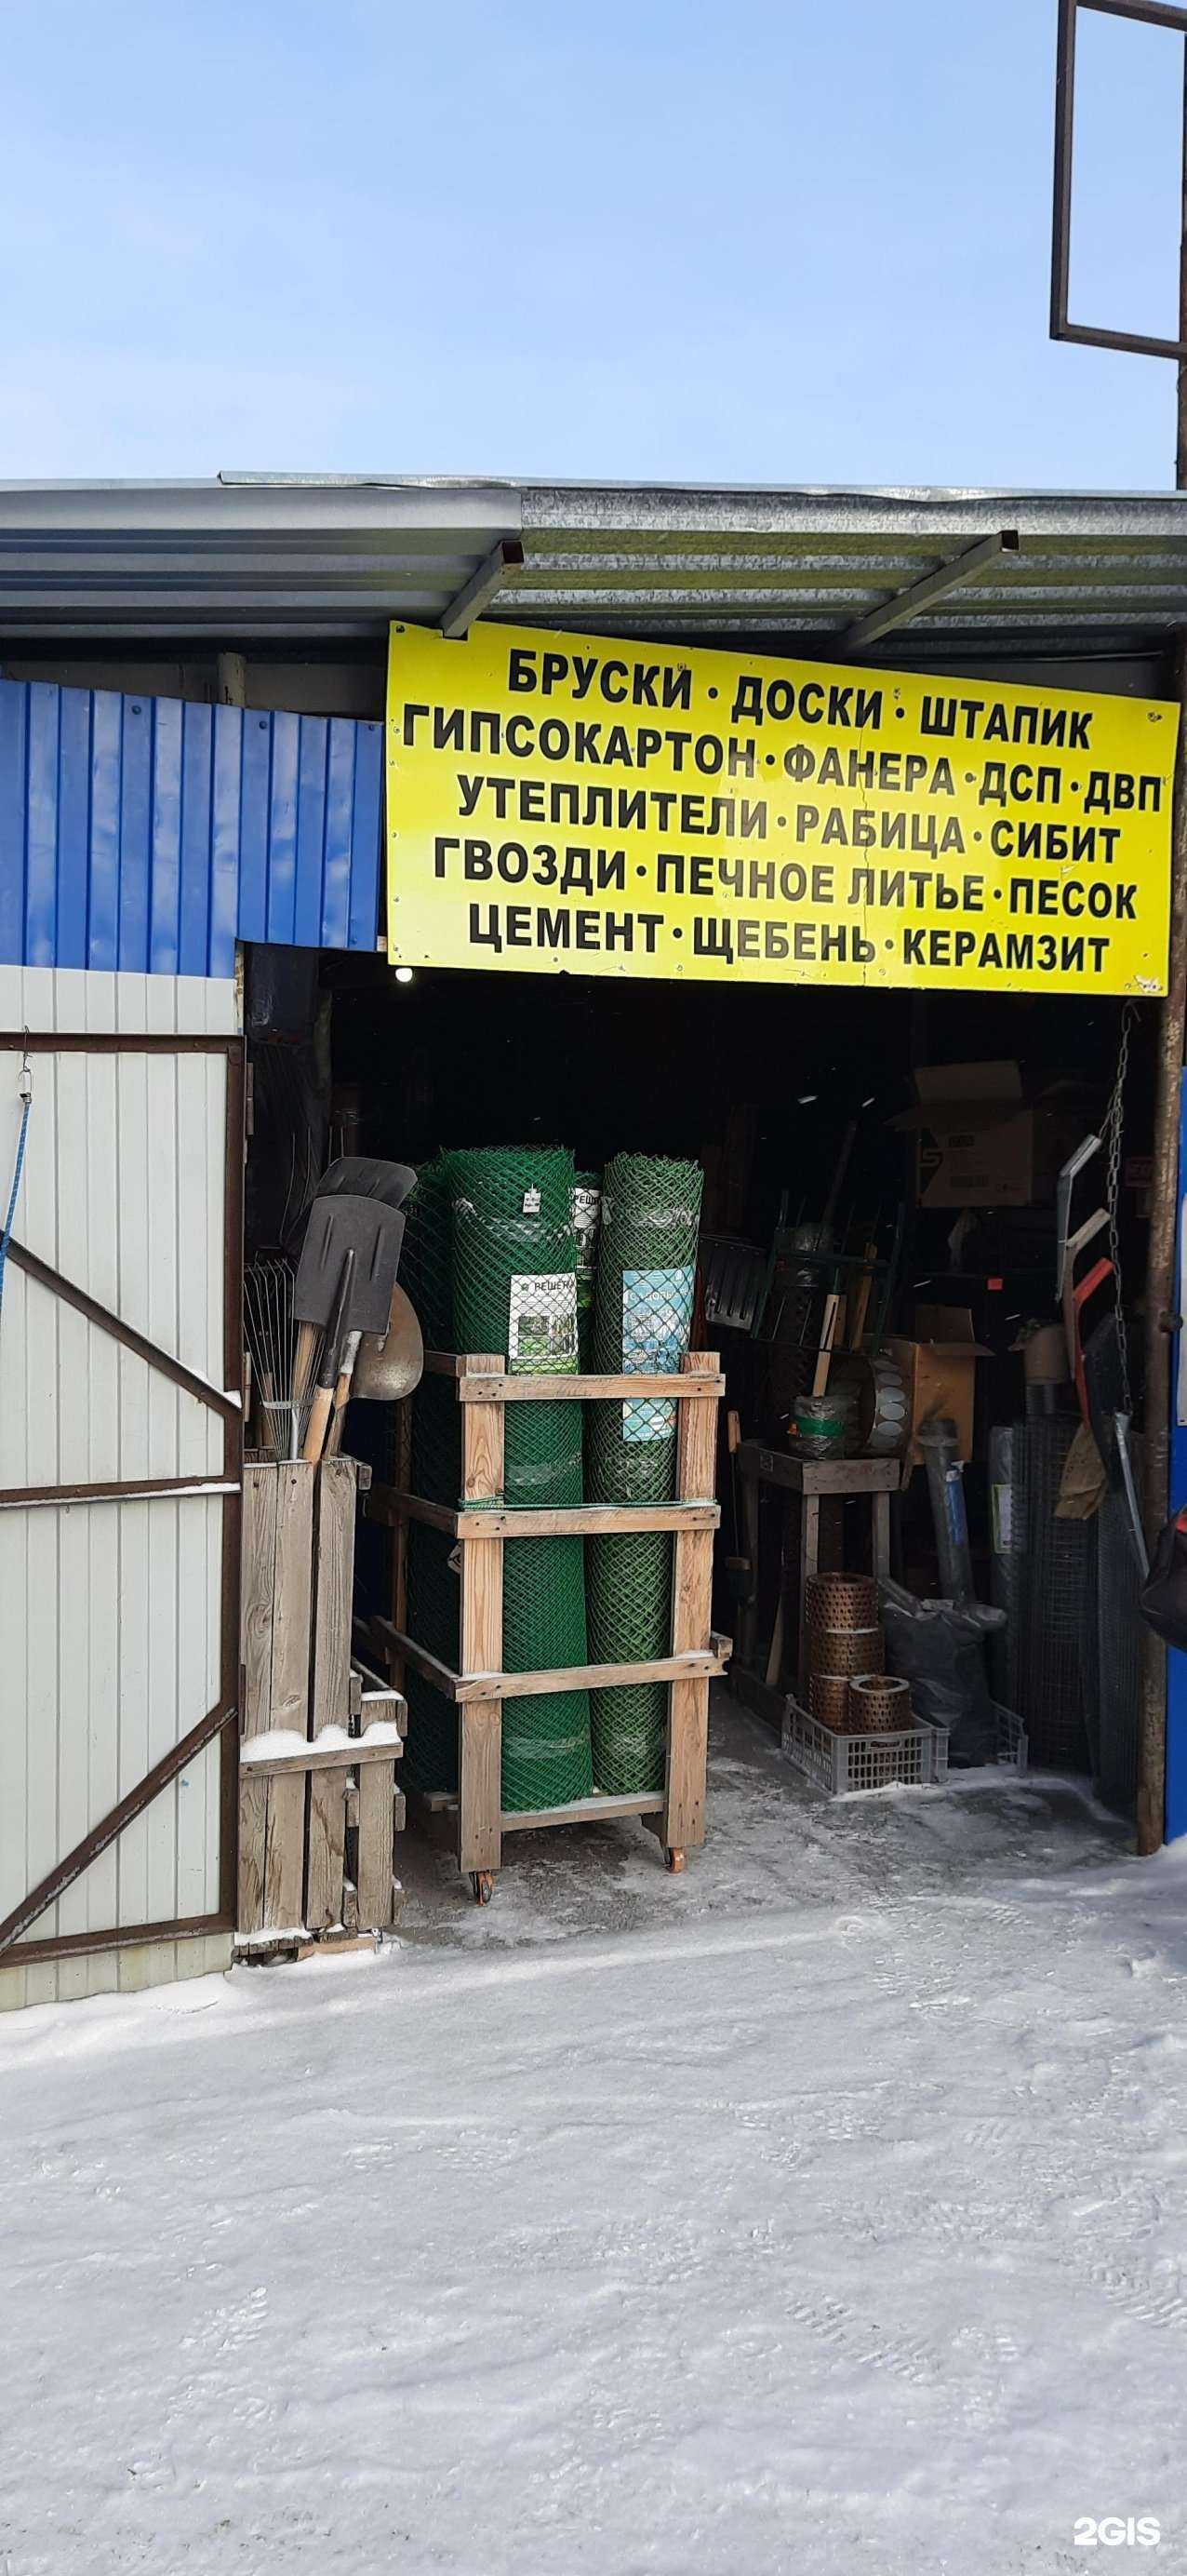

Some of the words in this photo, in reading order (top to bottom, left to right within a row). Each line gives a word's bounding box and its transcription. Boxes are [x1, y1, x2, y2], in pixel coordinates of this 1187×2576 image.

[507, 647, 694, 712] БРУСКИ
[729, 674, 885, 731] ДОСКИ
[919, 694, 1095, 752] ШТАПИК
[402, 702, 757, 779] ГИПСОКАРТОН
[782, 743, 955, 797] ФАНЕРА
[978, 759, 1063, 809] ДСП
[1082, 770, 1163, 817] ДВП
[455, 772, 768, 840] УТЕПЛИТЕЛИ
[794, 803, 967, 861] РАБИЦА
[990, 818, 1122, 865] СИБИТ
[433, 836, 627, 897] ГВОЗДИ
[655, 852, 835, 905] ПЕЧНОЕ
[847, 866, 985, 913] ЛИТЬЕ
[1008, 877, 1139, 920] ПЕСОК
[468, 902, 665, 955] ЦЕМЕНТ
[692, 915, 876, 966] ЩЕБЕНЬ
[902, 927, 1111, 973] КЕРАМЗИТ
